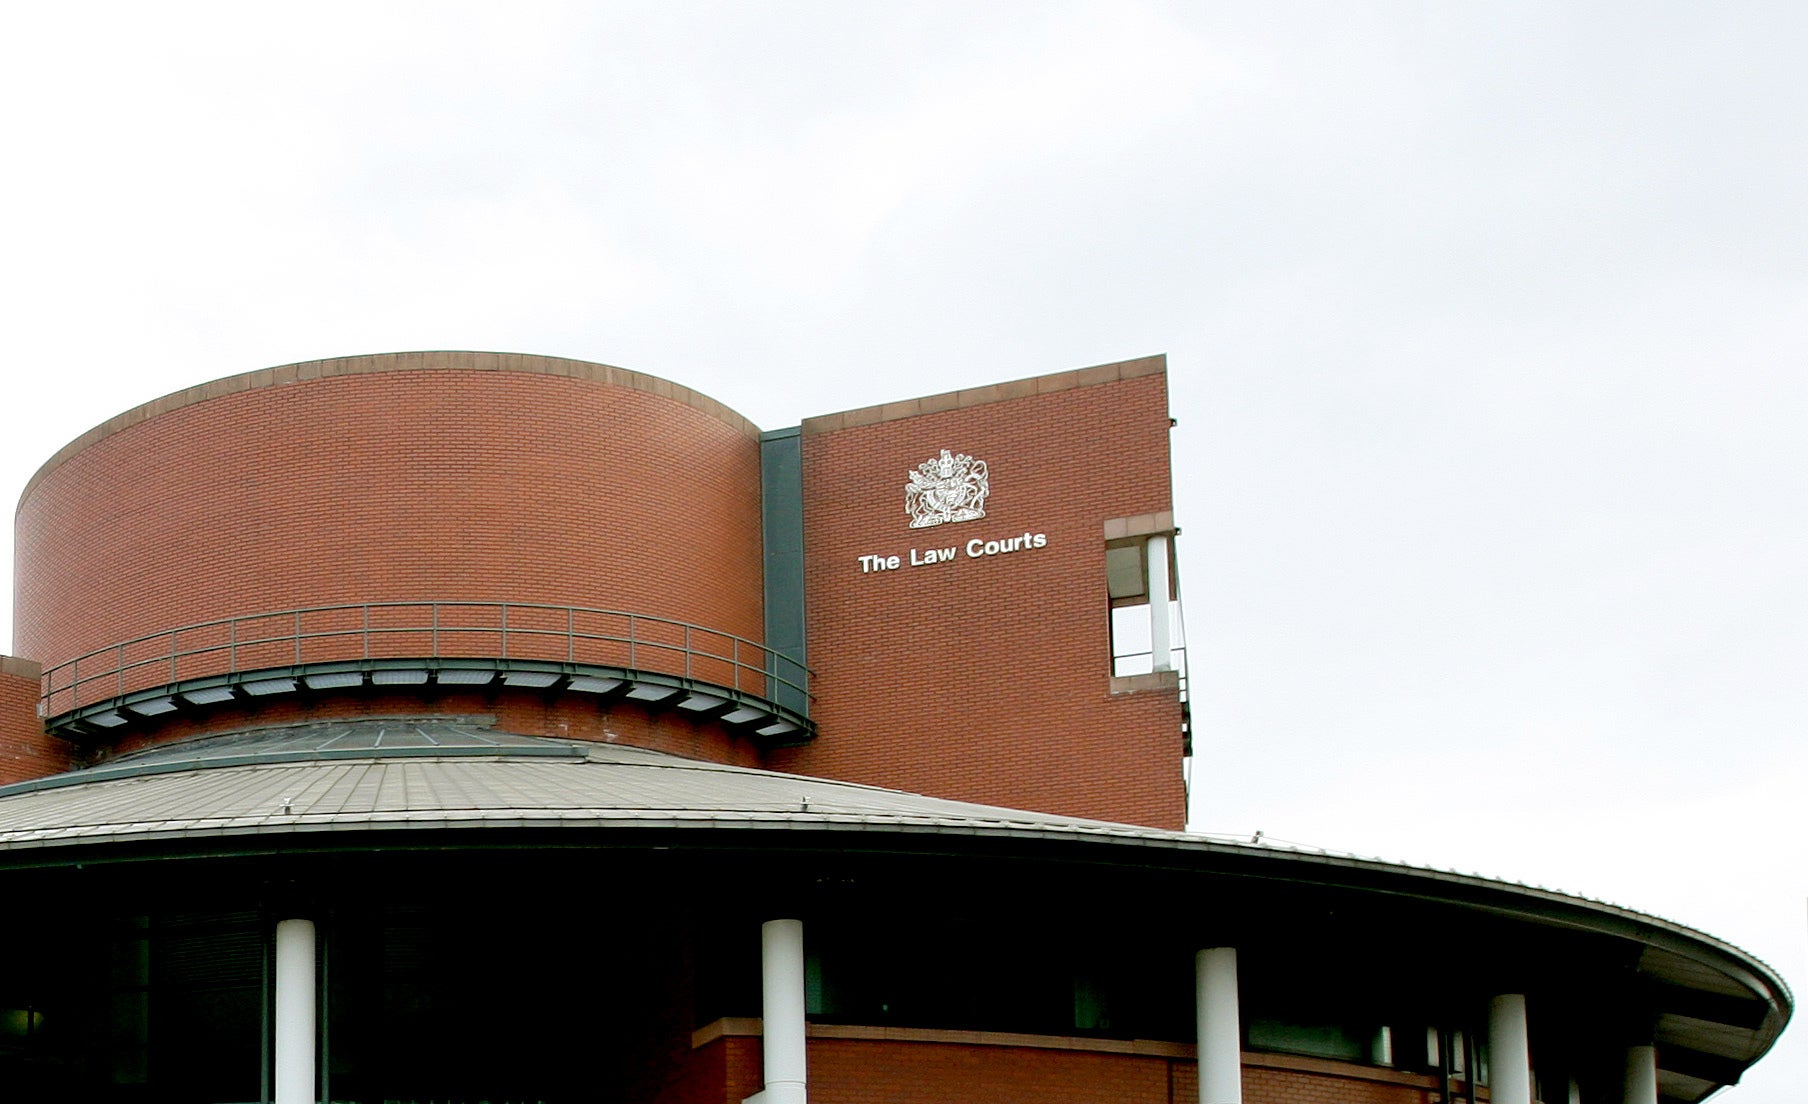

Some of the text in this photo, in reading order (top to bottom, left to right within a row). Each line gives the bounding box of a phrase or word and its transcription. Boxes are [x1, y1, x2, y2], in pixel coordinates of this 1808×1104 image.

[858, 532, 1047, 573] The Law Courts
